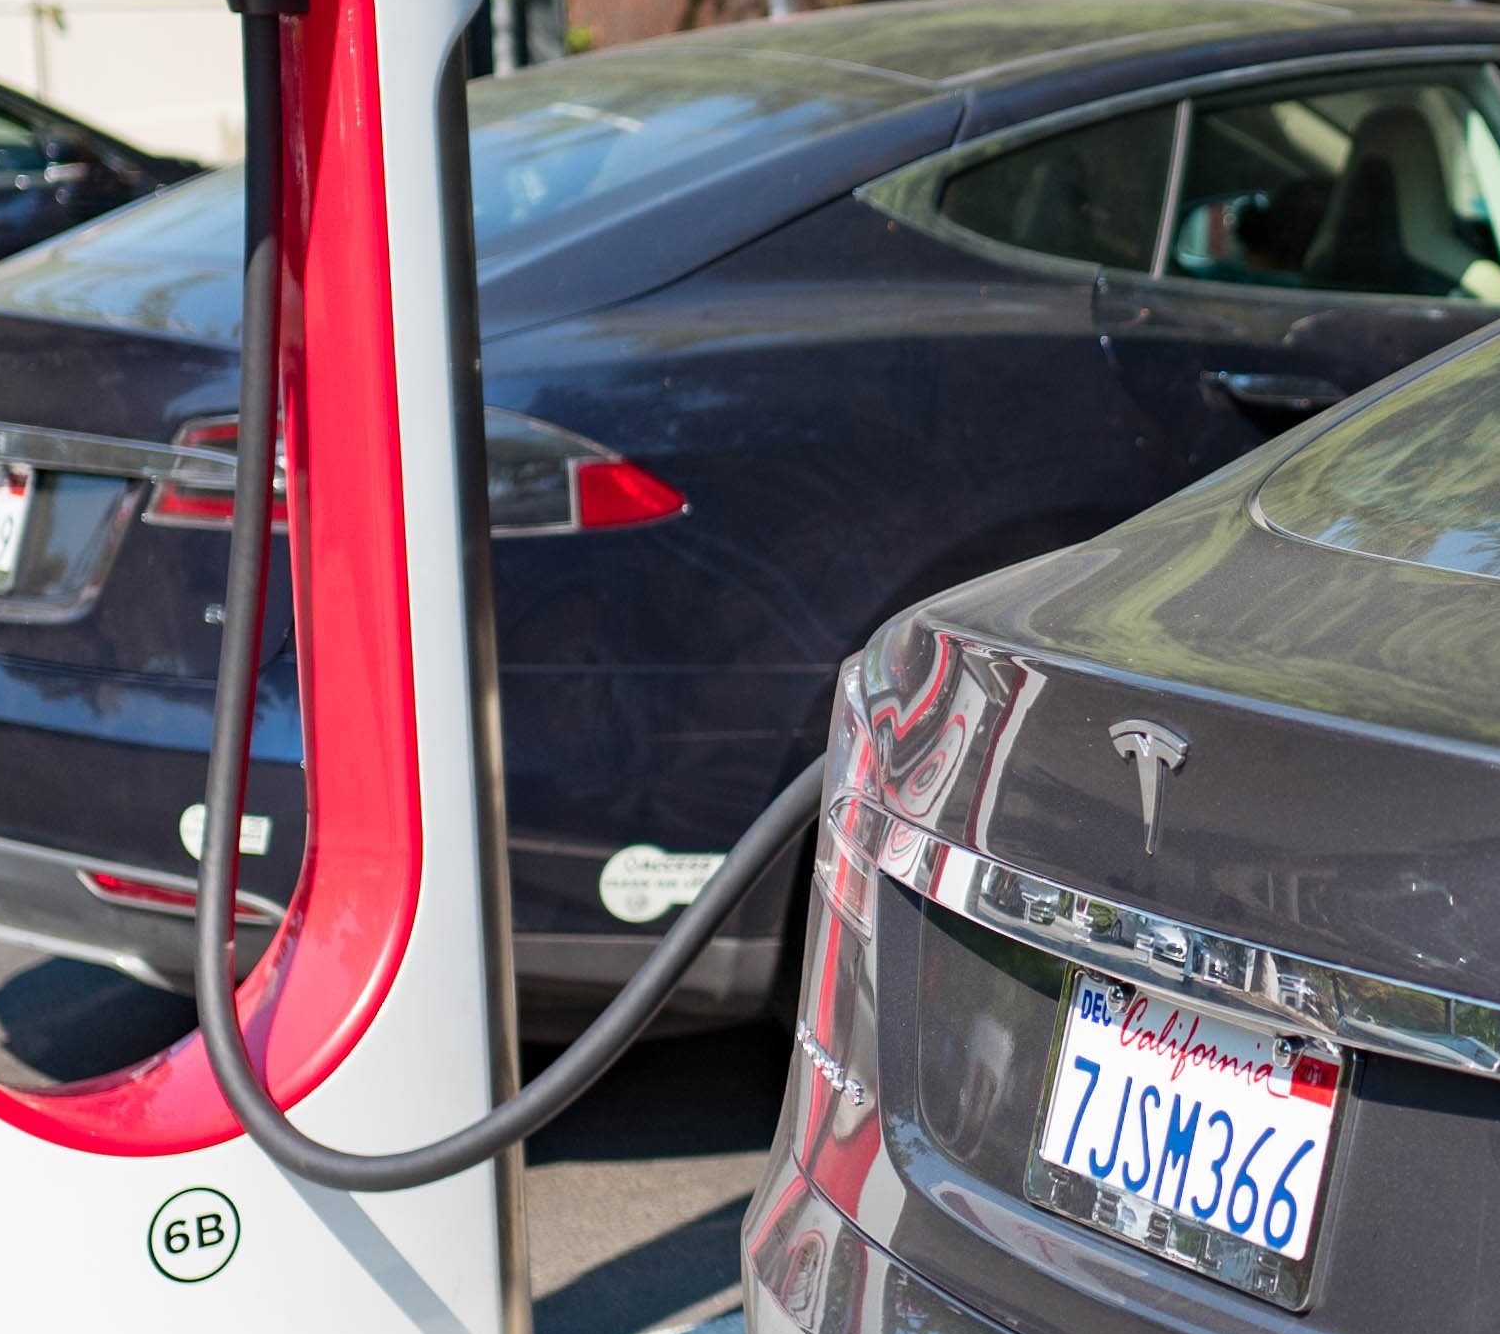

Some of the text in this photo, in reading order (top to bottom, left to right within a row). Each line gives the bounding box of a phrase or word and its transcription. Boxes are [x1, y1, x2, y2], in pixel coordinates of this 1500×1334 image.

[1080, 989, 1112, 1027] DEC
[1119, 996, 1289, 1099] California
[1061, 1055, 1316, 1251] 7JSM366
[164, 1213, 225, 1255] 6B
[1048, 1169, 1282, 1295] TESLA
